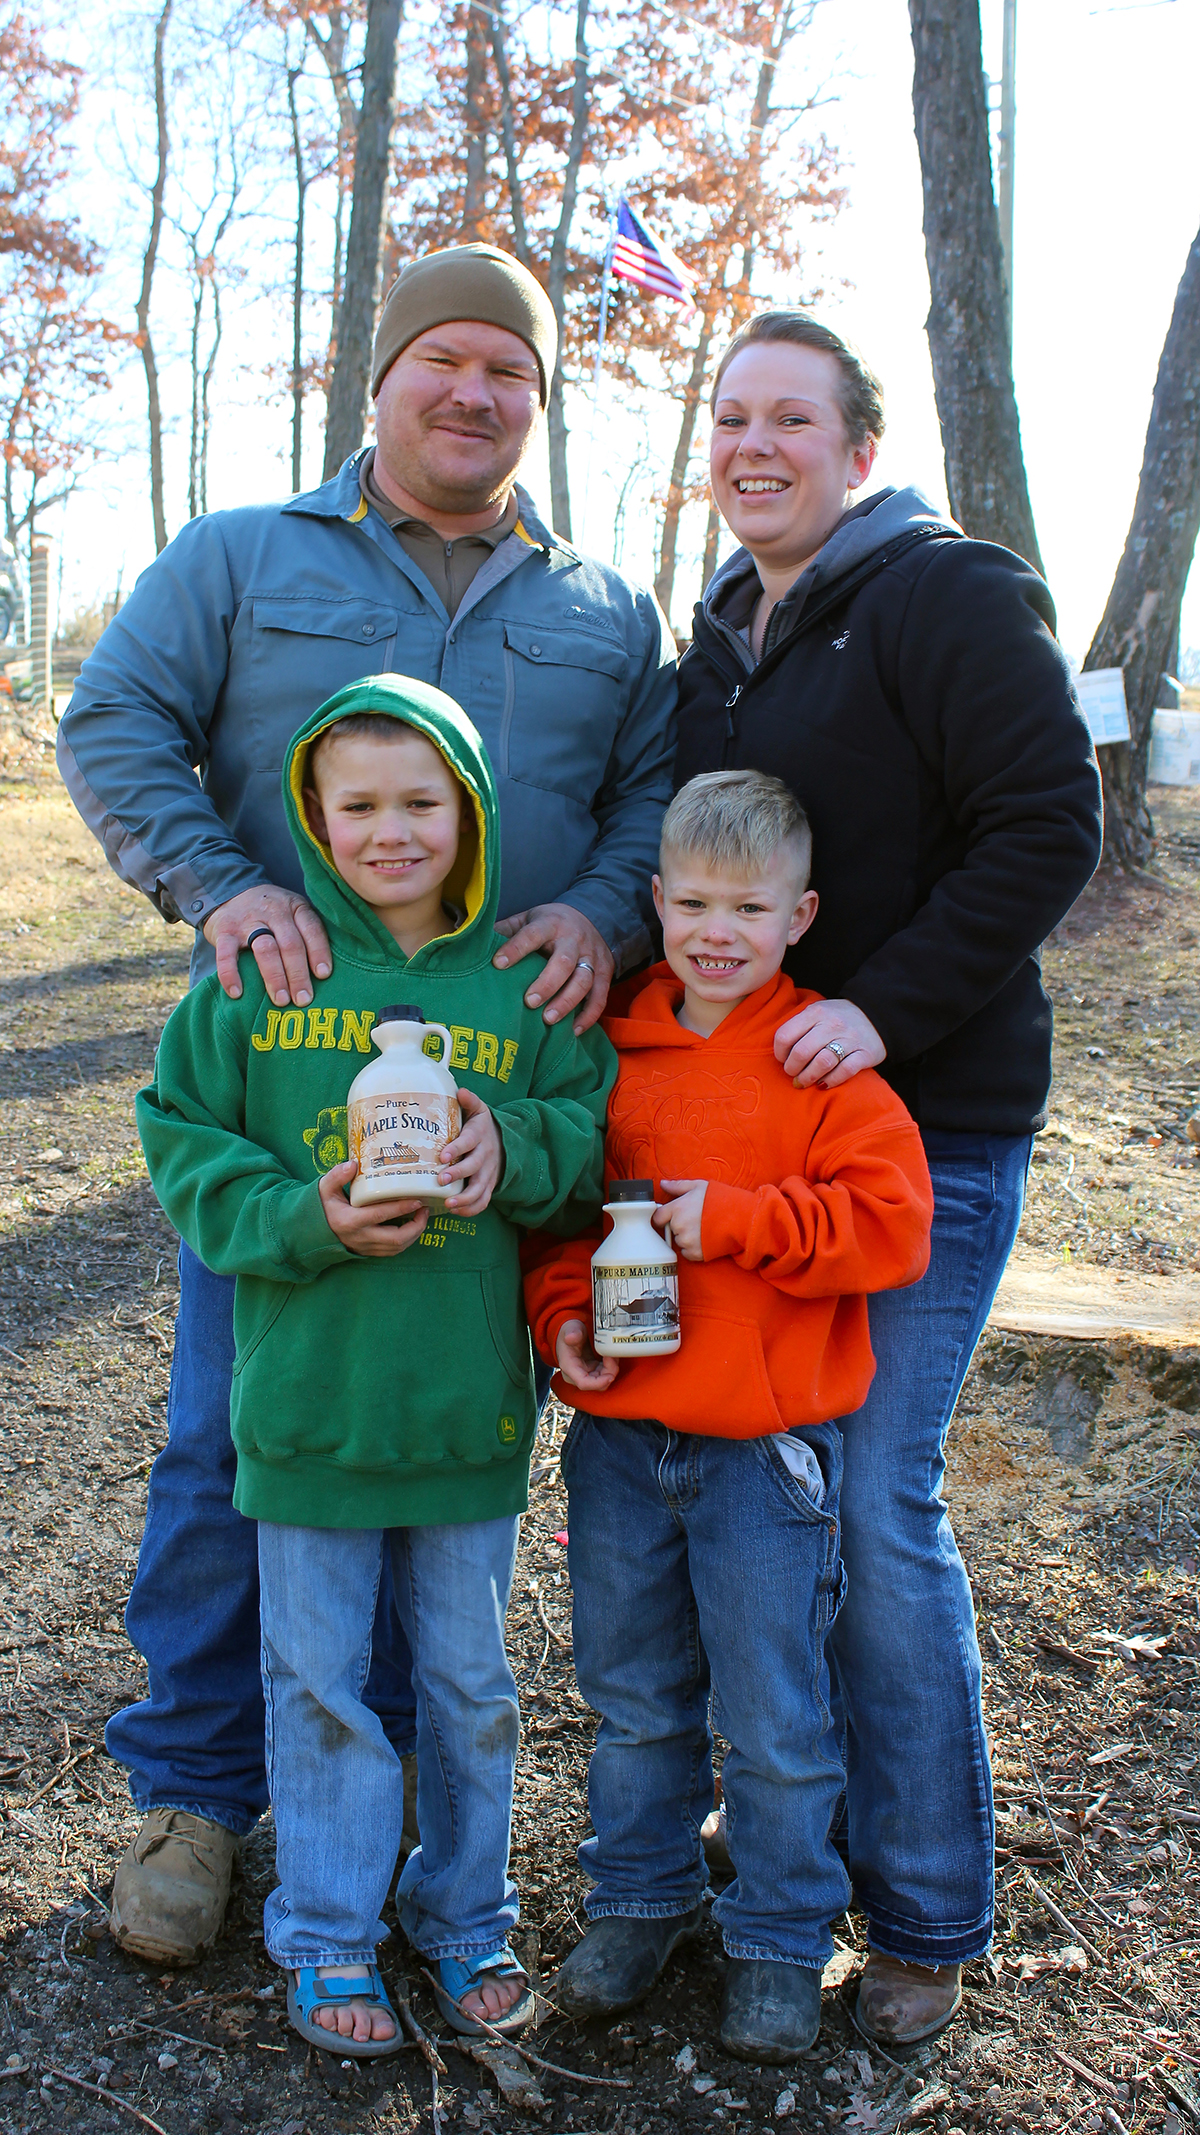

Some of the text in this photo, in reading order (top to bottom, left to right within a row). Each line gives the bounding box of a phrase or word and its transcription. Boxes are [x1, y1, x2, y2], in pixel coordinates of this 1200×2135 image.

[251, 1008, 519, 1084] JOHN EERE
[386, 1100, 408, 1108] Pure
[361, 1112, 440, 1139] MAPLE SYRUP
[433, 1217, 477, 1236] ILLINOIS
[420, 1233, 446, 1248] 1837
[604, 1265, 677, 1277] PURE MAPLE SYR
